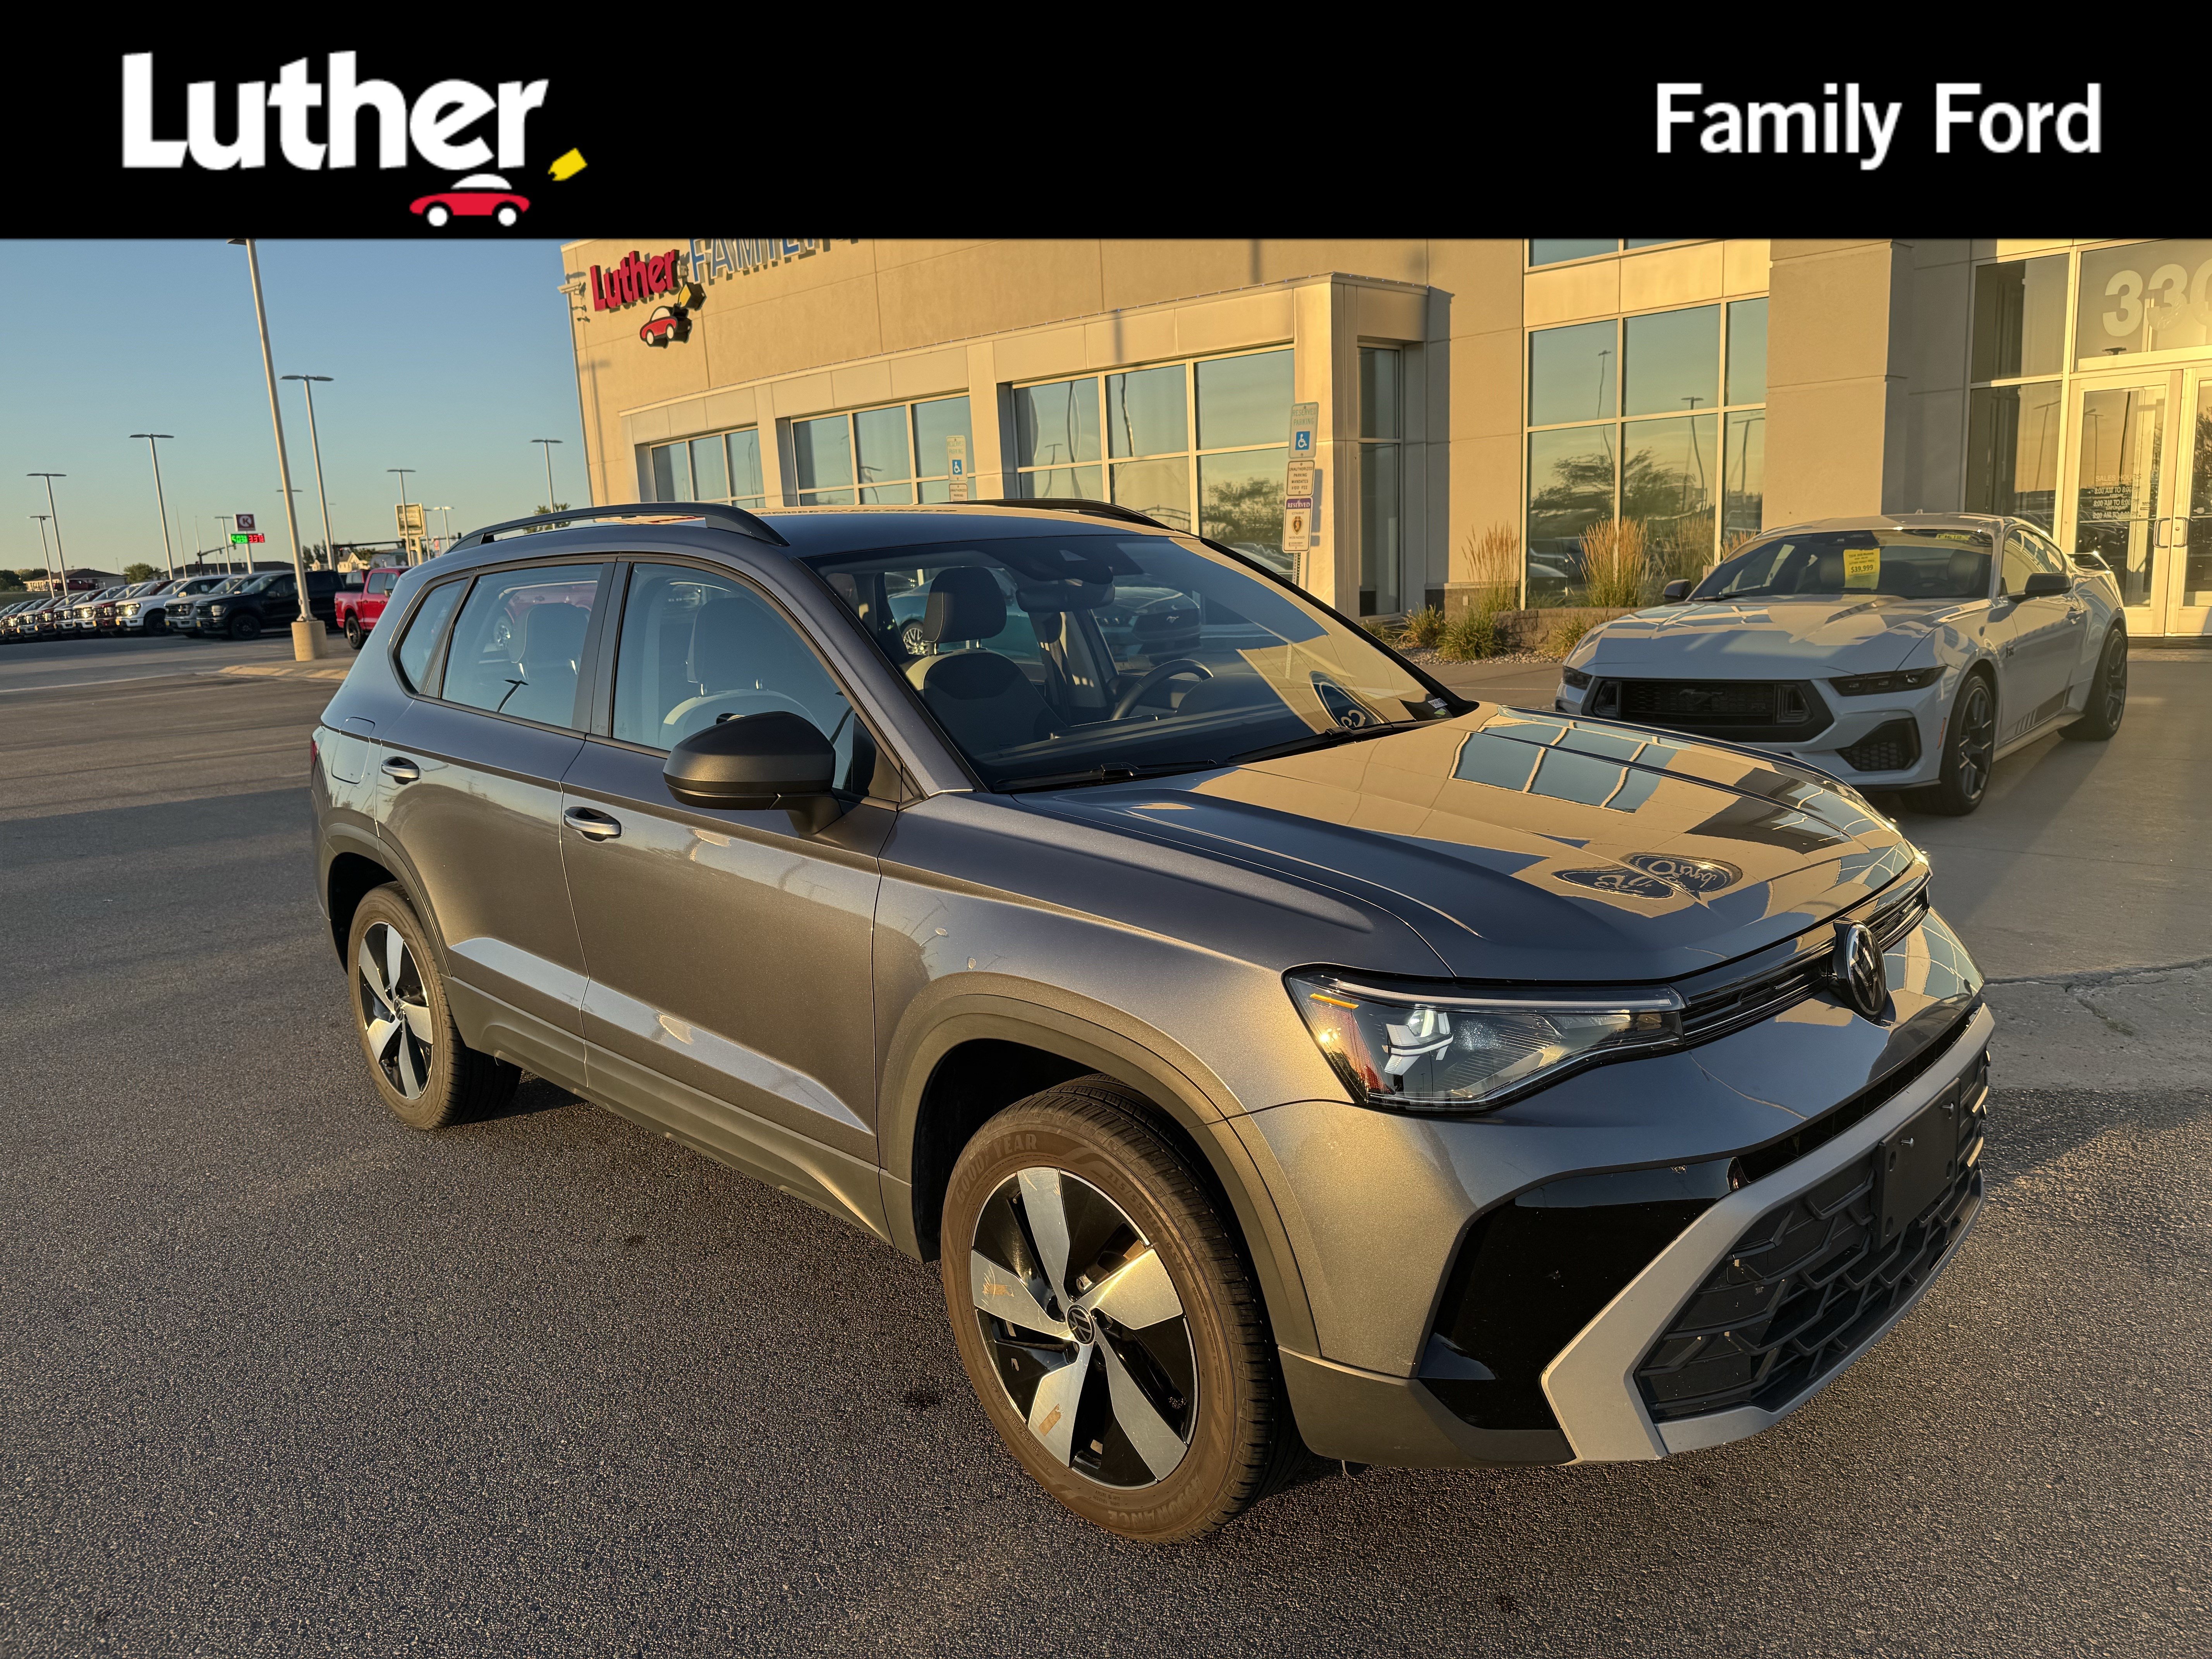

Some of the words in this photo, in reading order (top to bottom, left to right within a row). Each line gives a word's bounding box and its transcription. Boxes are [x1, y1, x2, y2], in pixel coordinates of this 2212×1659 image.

[590, 249, 679, 312] Luther
[1292, 408, 1316, 417] RESERVED
[1293, 417, 1314, 426] PARKING
[1851, 564, 1874, 573] $39,999
[993, 1133, 1037, 1159] YEAR
